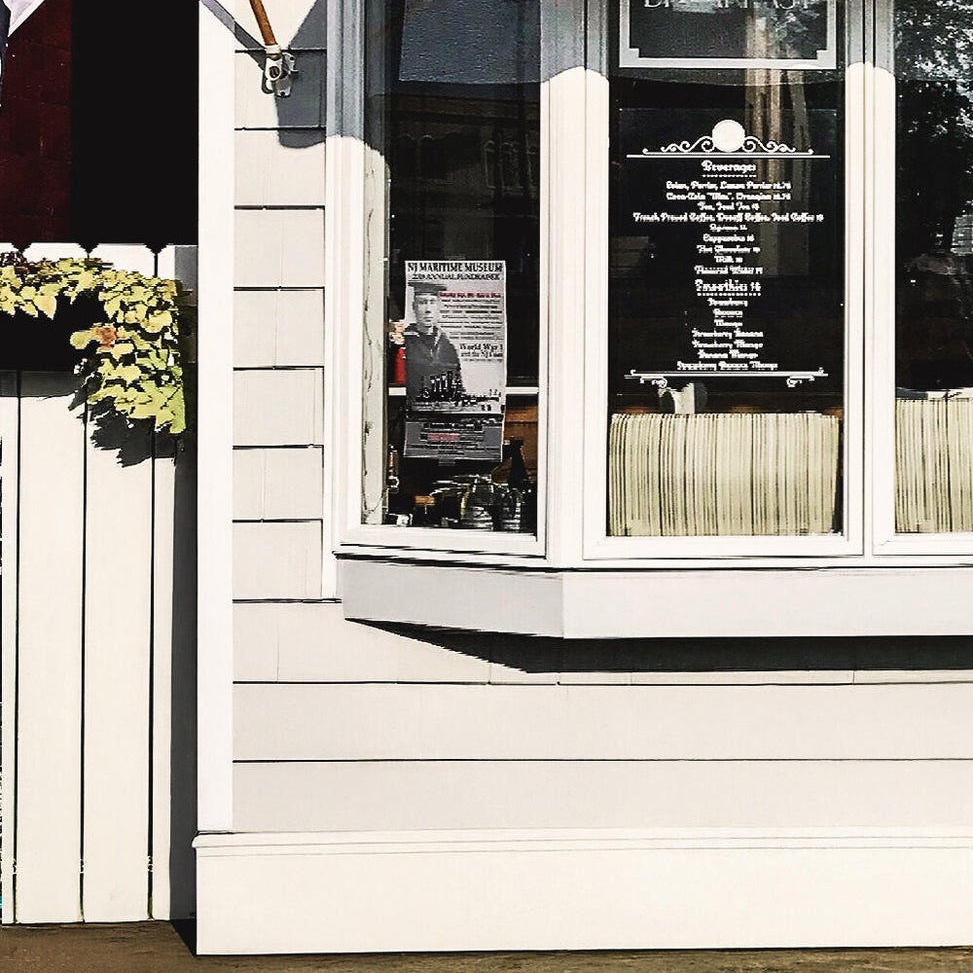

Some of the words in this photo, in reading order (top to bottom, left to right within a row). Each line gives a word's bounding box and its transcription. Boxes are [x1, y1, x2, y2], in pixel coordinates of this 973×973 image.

[701, 160, 757, 174] Beverages
[420, 262, 463, 273] MARITIME
[464, 262, 503, 273] MUSEUM
